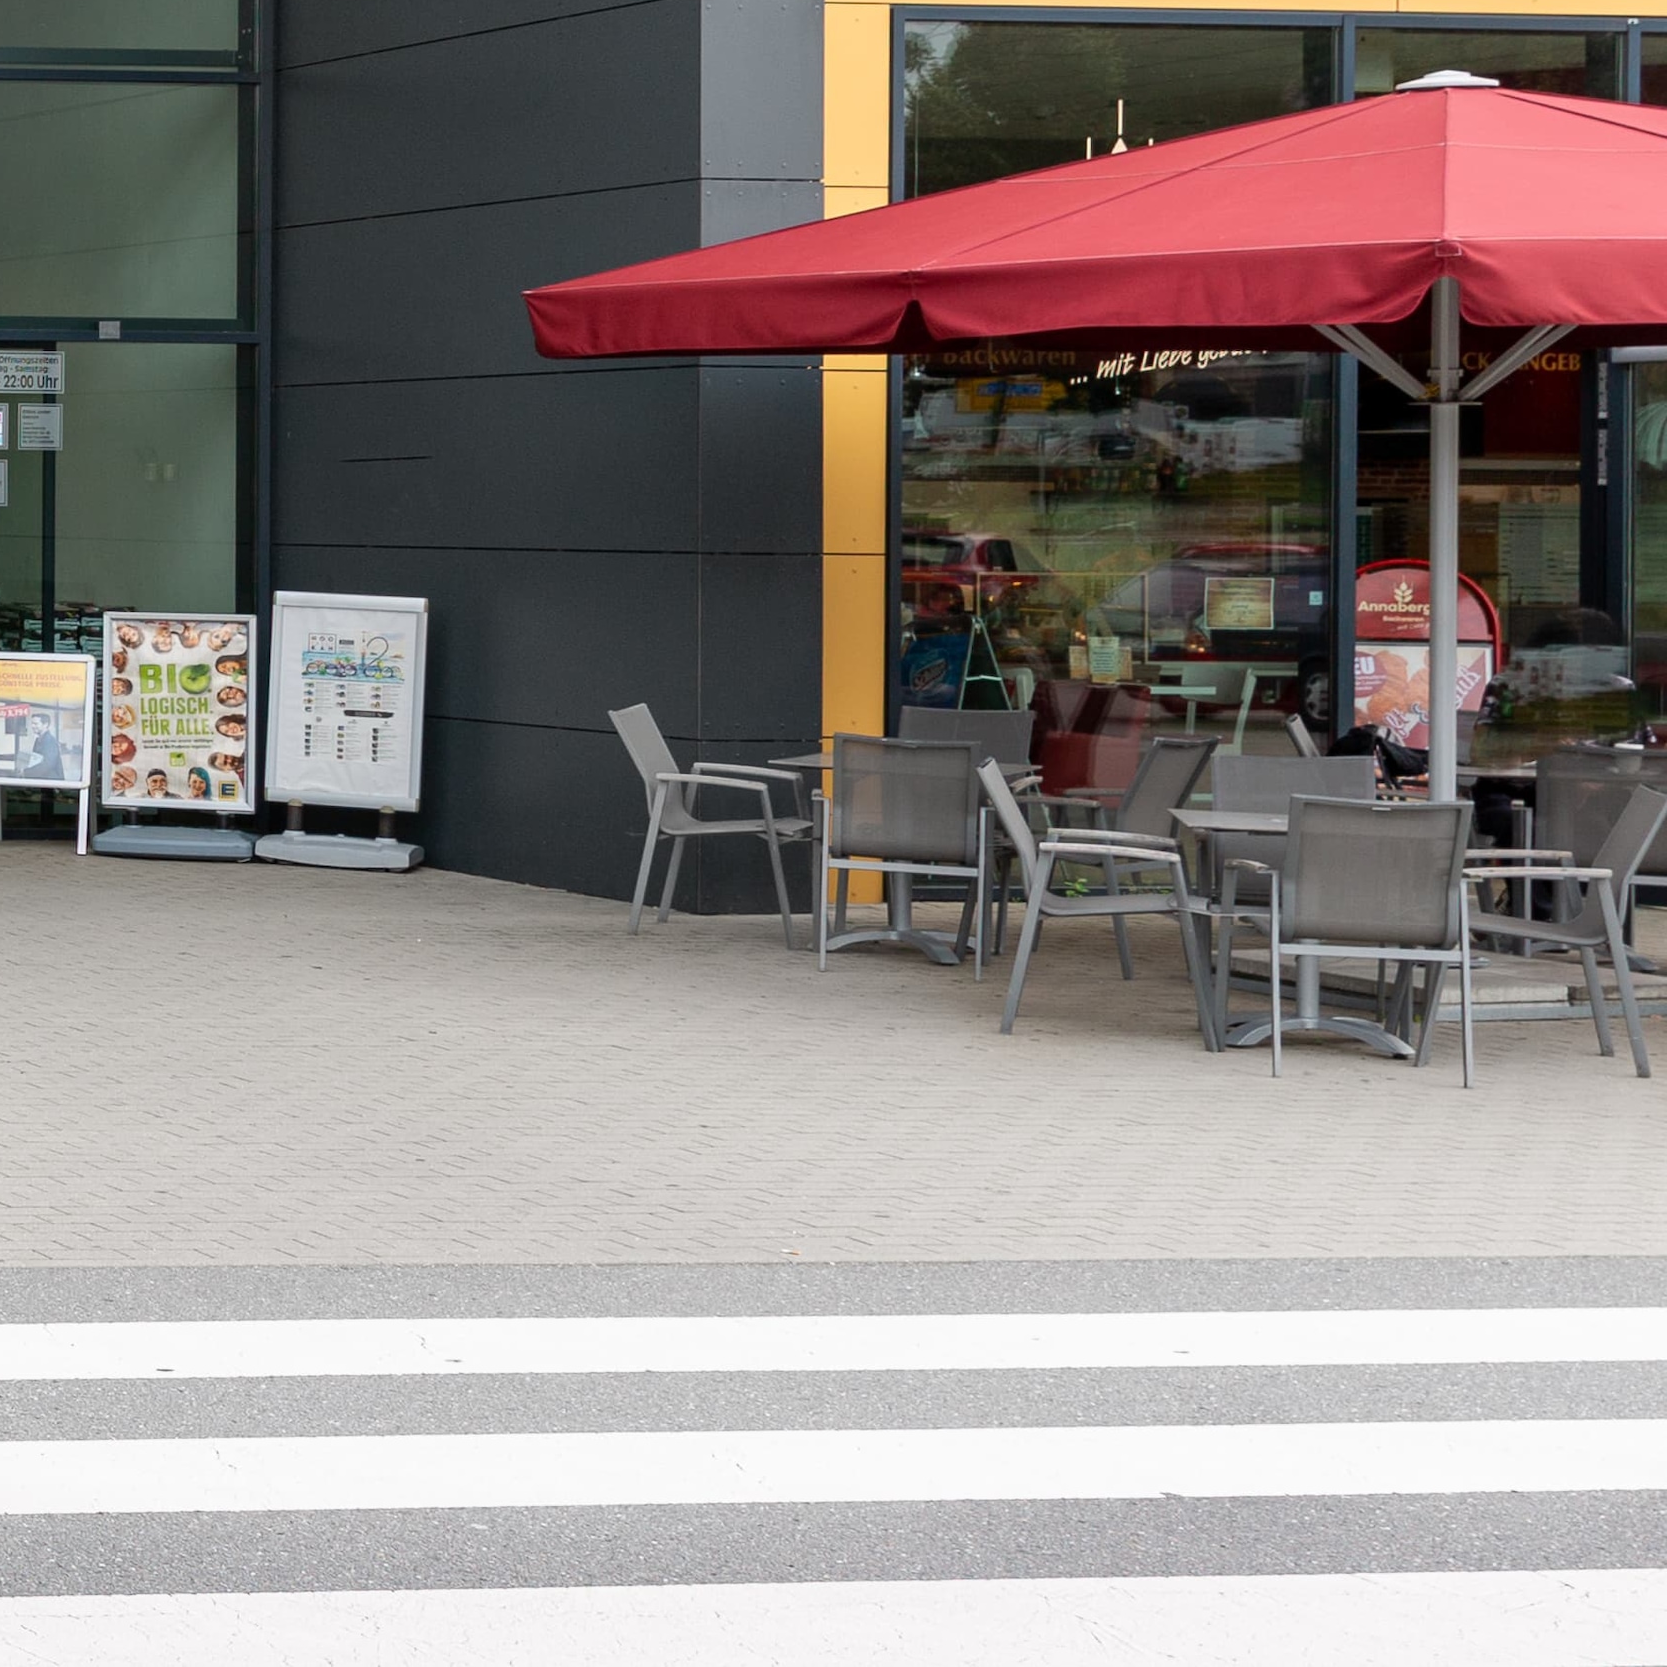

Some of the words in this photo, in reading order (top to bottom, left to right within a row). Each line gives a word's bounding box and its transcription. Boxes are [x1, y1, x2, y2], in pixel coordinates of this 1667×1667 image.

[3, 375, 34, 388] 22:00
[37, 375, 59, 389] Uhr
[141, 697, 213, 714] LOGISCH.
[141, 715, 170, 736] FÜR
[176, 718, 214, 736] ALLE.
